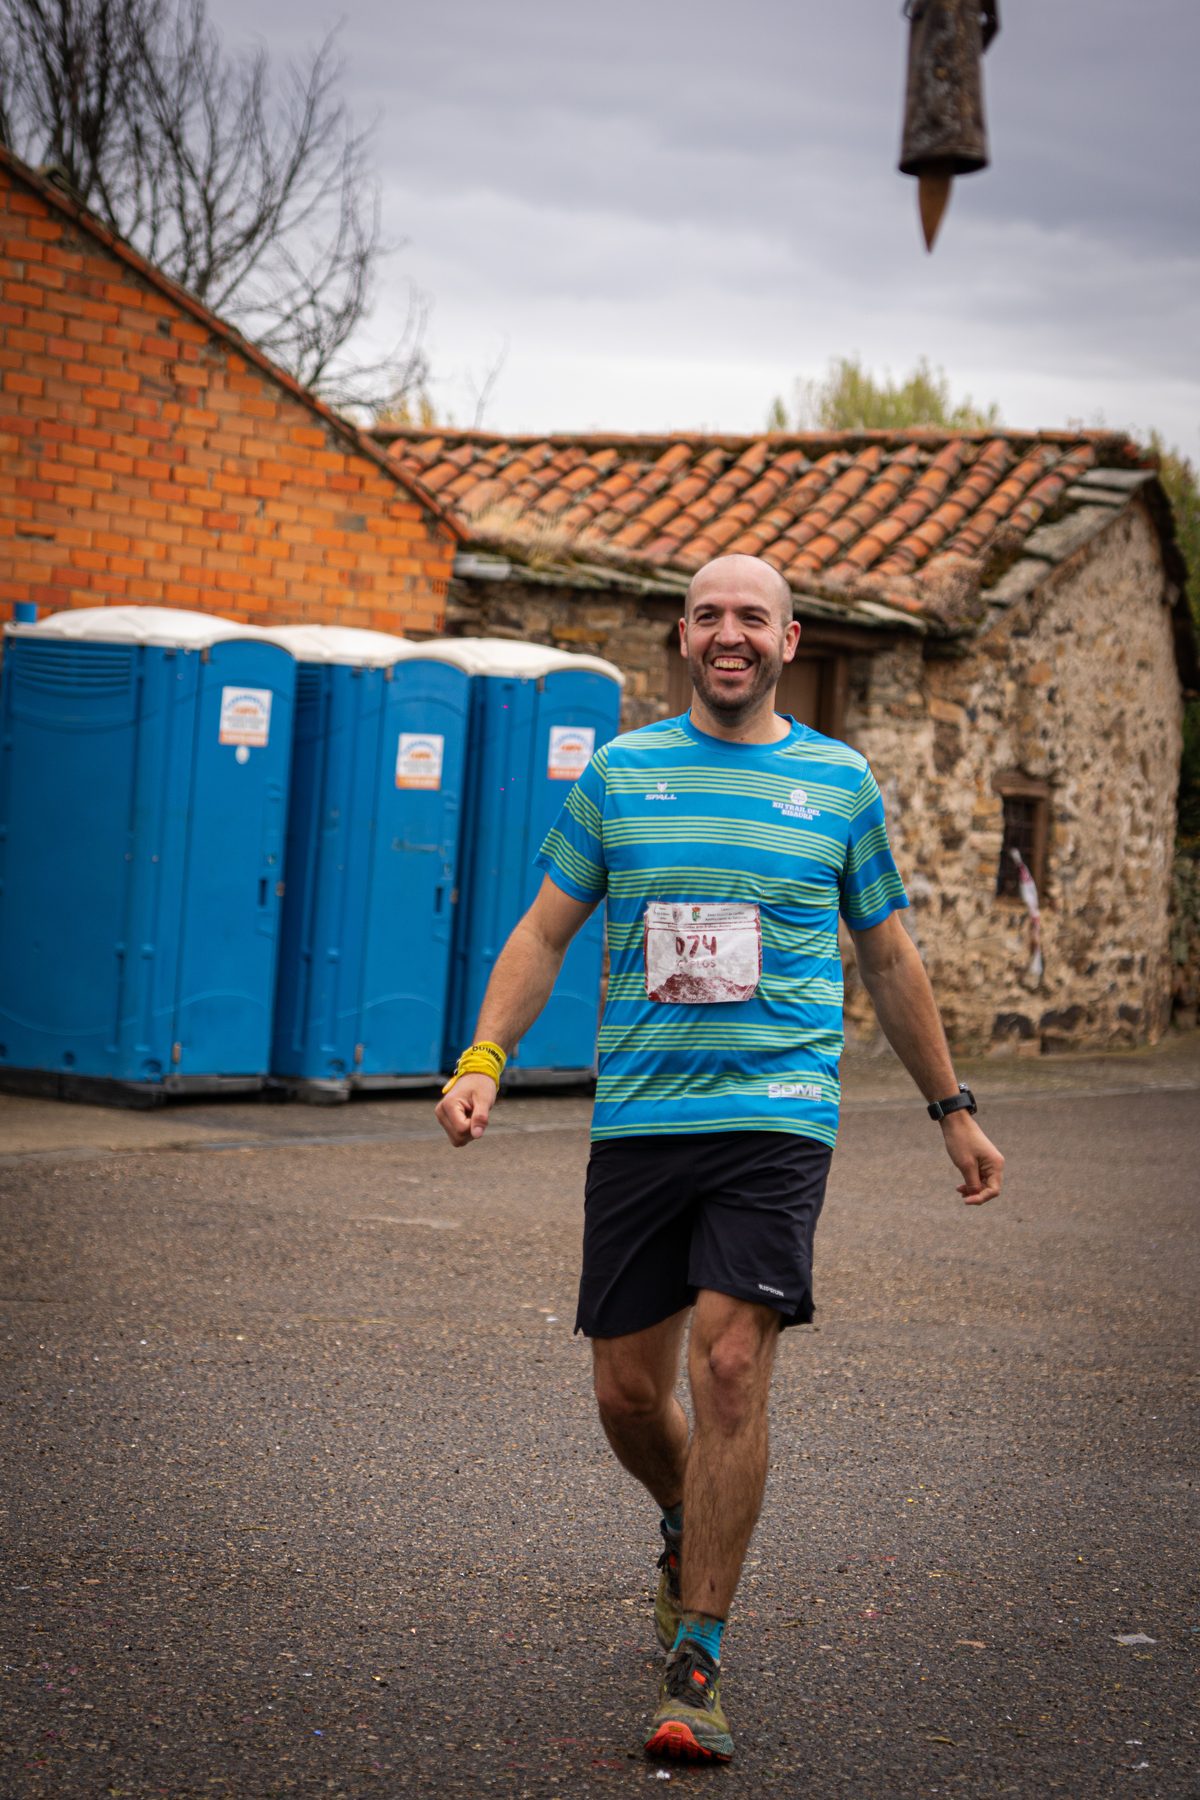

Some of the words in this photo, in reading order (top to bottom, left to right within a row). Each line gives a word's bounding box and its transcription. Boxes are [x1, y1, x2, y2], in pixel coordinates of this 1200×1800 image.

[784, 803, 806, 812] TRAIL
[806, 807, 821, 817] DEL
[675, 934, 718, 958] 074
